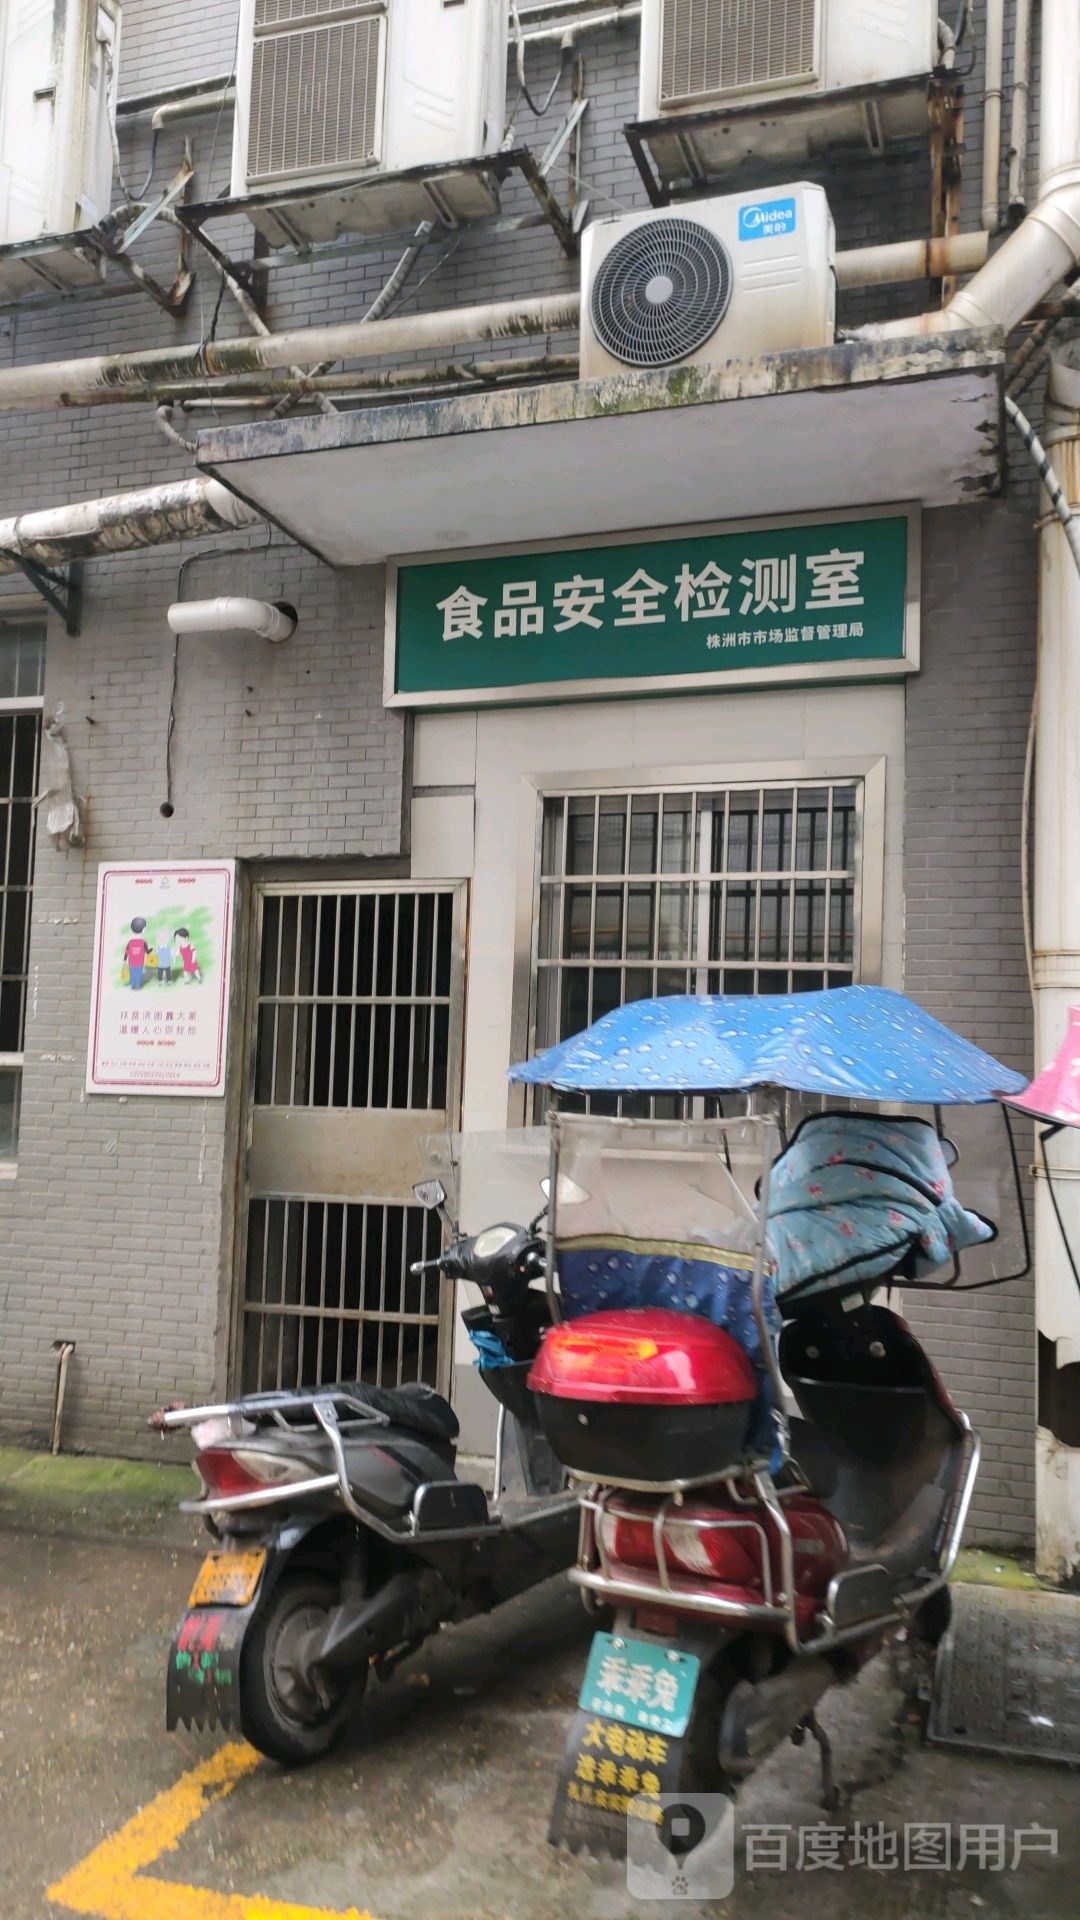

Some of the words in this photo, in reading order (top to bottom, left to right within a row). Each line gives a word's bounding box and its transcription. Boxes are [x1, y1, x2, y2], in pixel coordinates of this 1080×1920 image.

[743, 206, 793, 229] Midea
[763, 221, 787, 235] 美的
[436, 548, 865, 641] 食品安全检测室
[706, 622, 864, 649] 株洲市市场监督管理局
